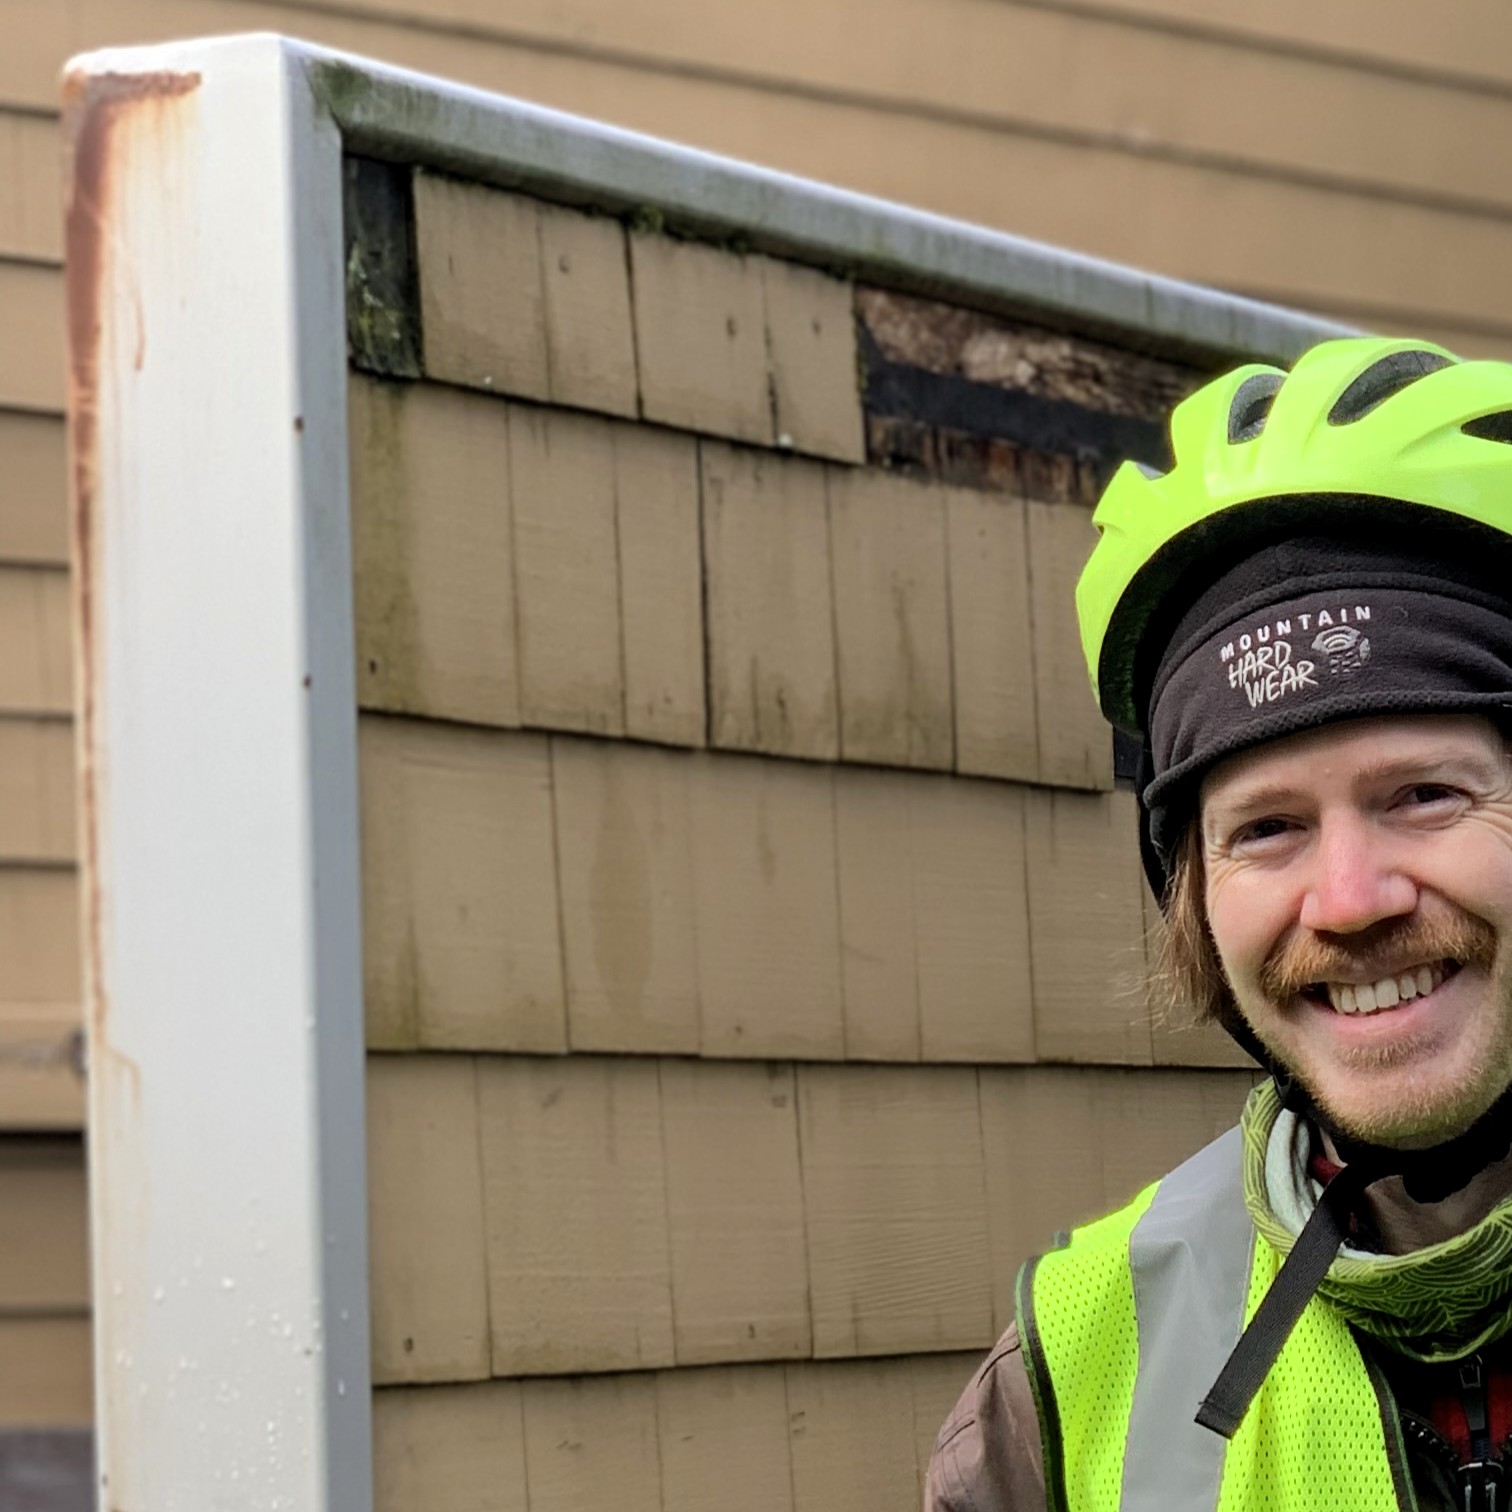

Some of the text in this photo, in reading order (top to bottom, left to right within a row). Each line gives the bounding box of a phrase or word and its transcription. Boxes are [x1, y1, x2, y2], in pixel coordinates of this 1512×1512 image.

[1220, 605, 1371, 662] MOUNTAIN
[1228, 640, 1292, 689] HARD
[1245, 660, 1319, 708] WEAR
